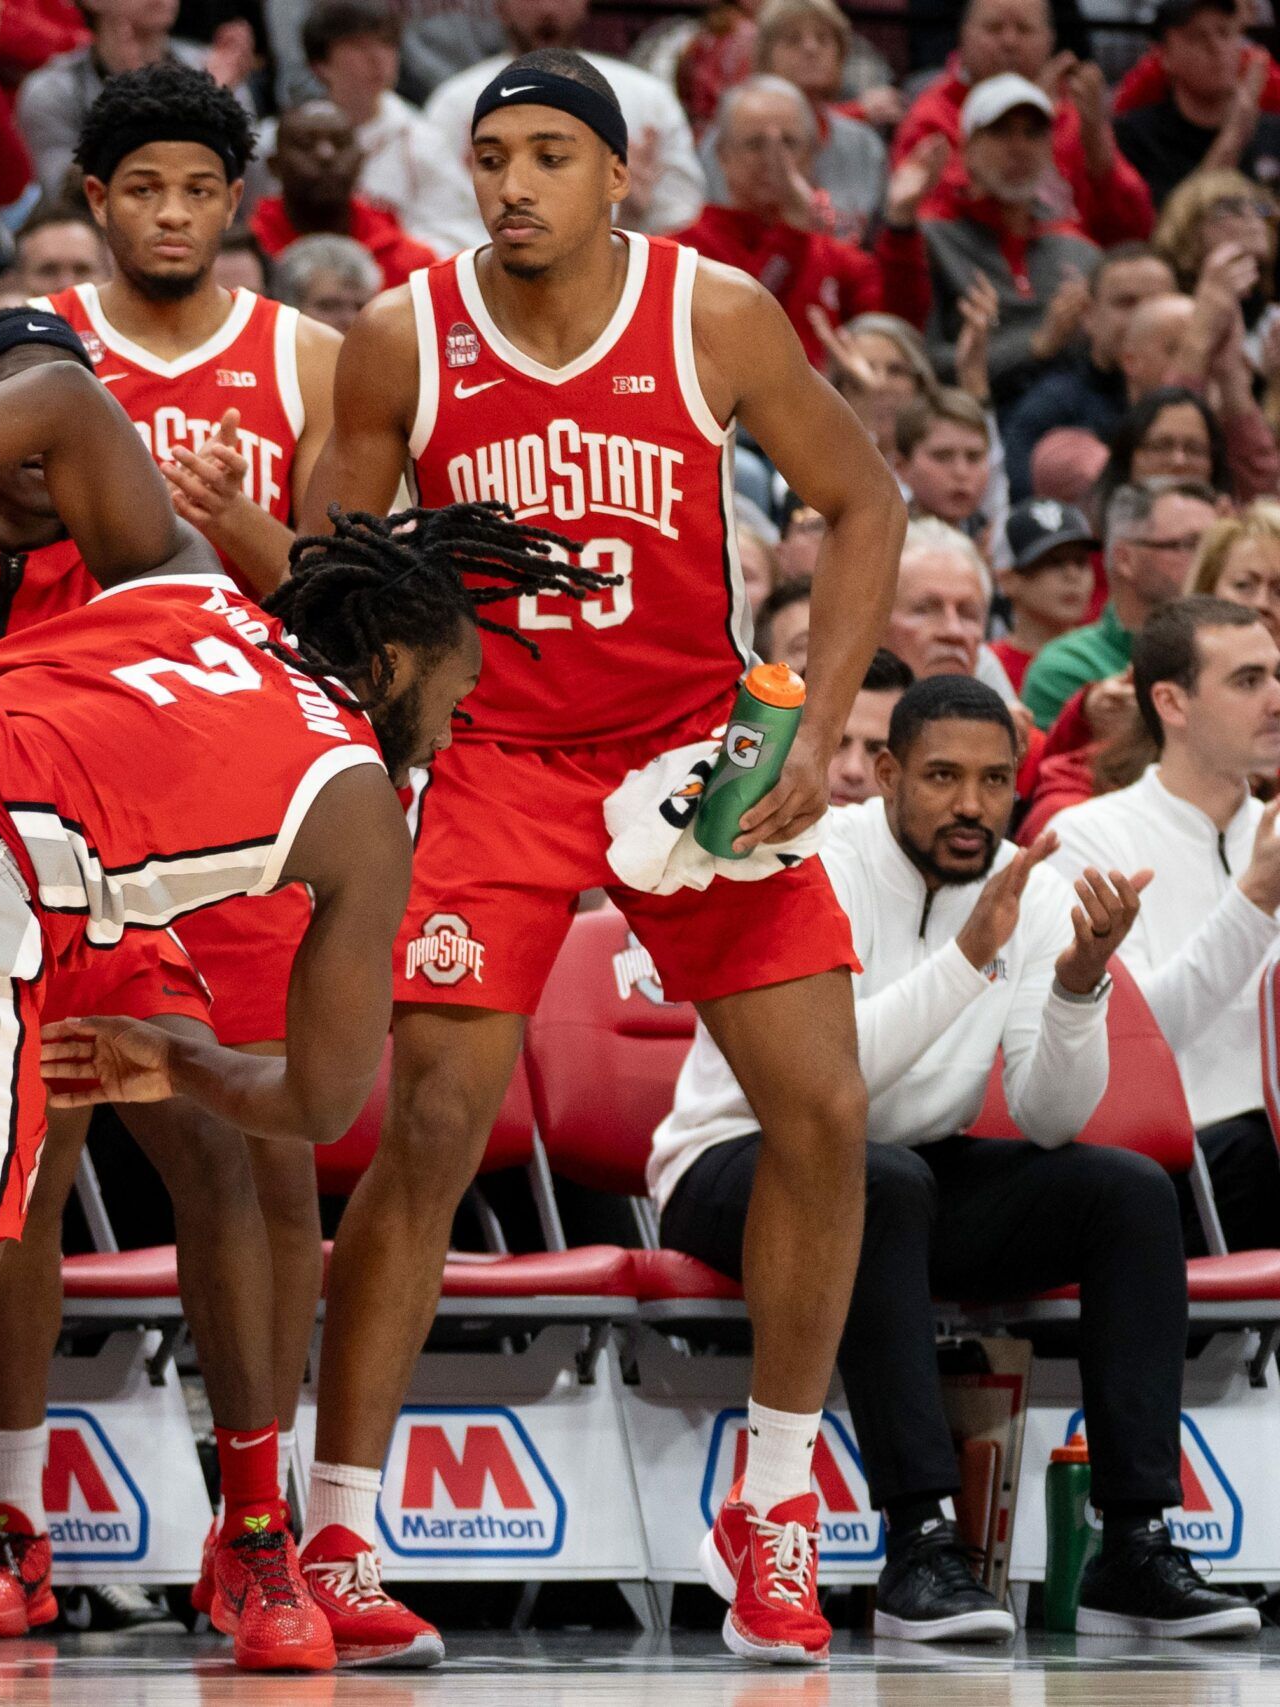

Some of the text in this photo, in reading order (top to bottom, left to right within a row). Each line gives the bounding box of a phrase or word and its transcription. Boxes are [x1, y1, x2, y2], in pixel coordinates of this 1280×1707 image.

[518, 537, 634, 630] 23
[109, 635, 263, 707] 2
[50, 1518, 131, 1543] athon
[402, 1514, 545, 1539] Marathon
